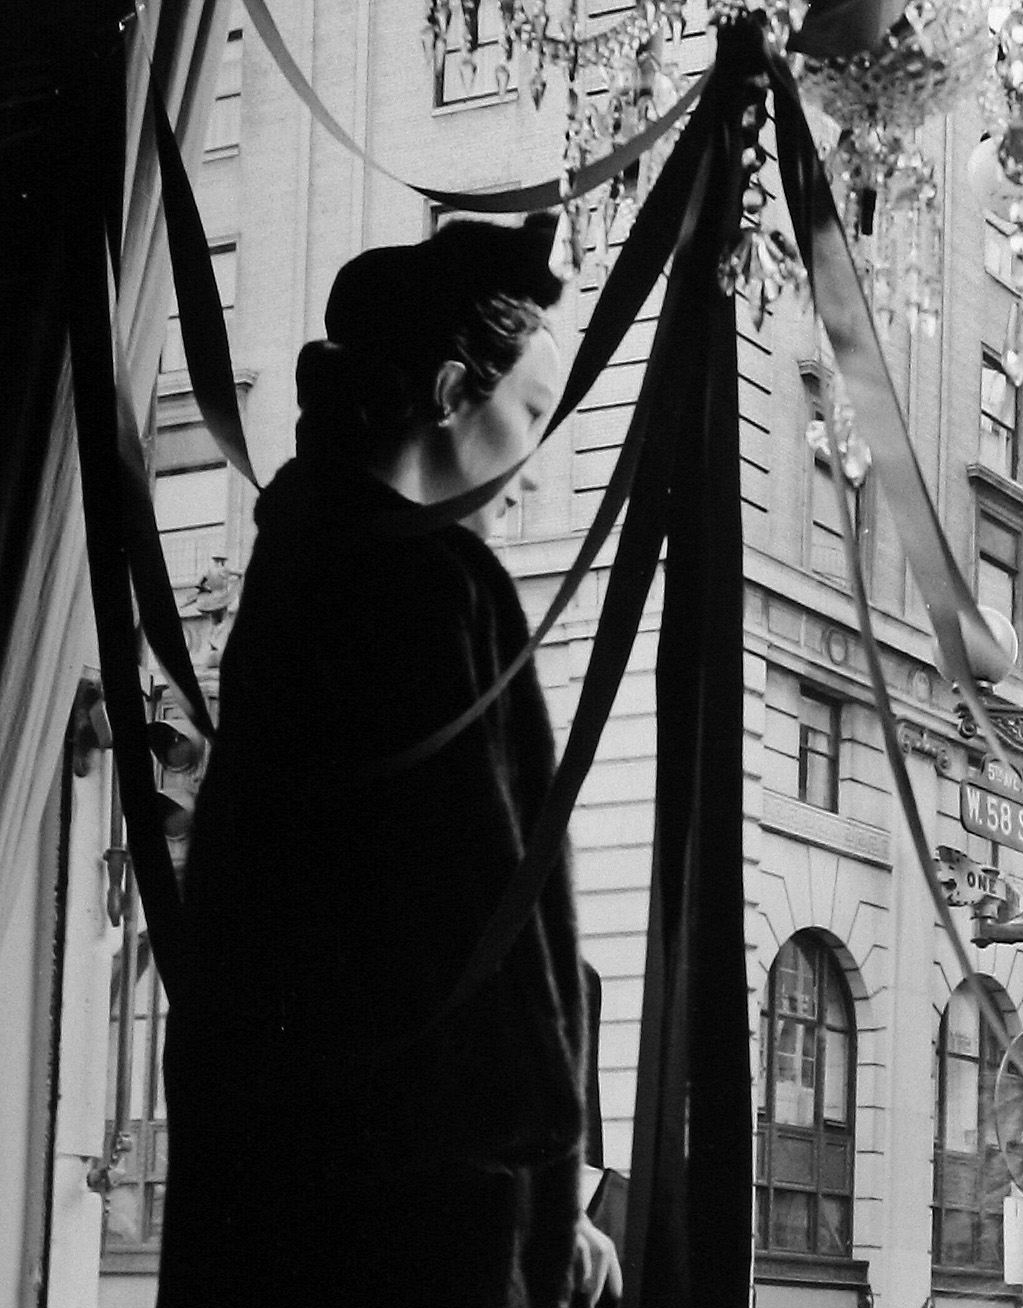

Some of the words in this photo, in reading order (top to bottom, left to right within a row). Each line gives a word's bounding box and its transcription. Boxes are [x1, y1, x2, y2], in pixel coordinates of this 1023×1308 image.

[966, 786, 983, 826] W.
[986, 795, 1012, 836] 58
[967, 871, 997, 894] ONE
